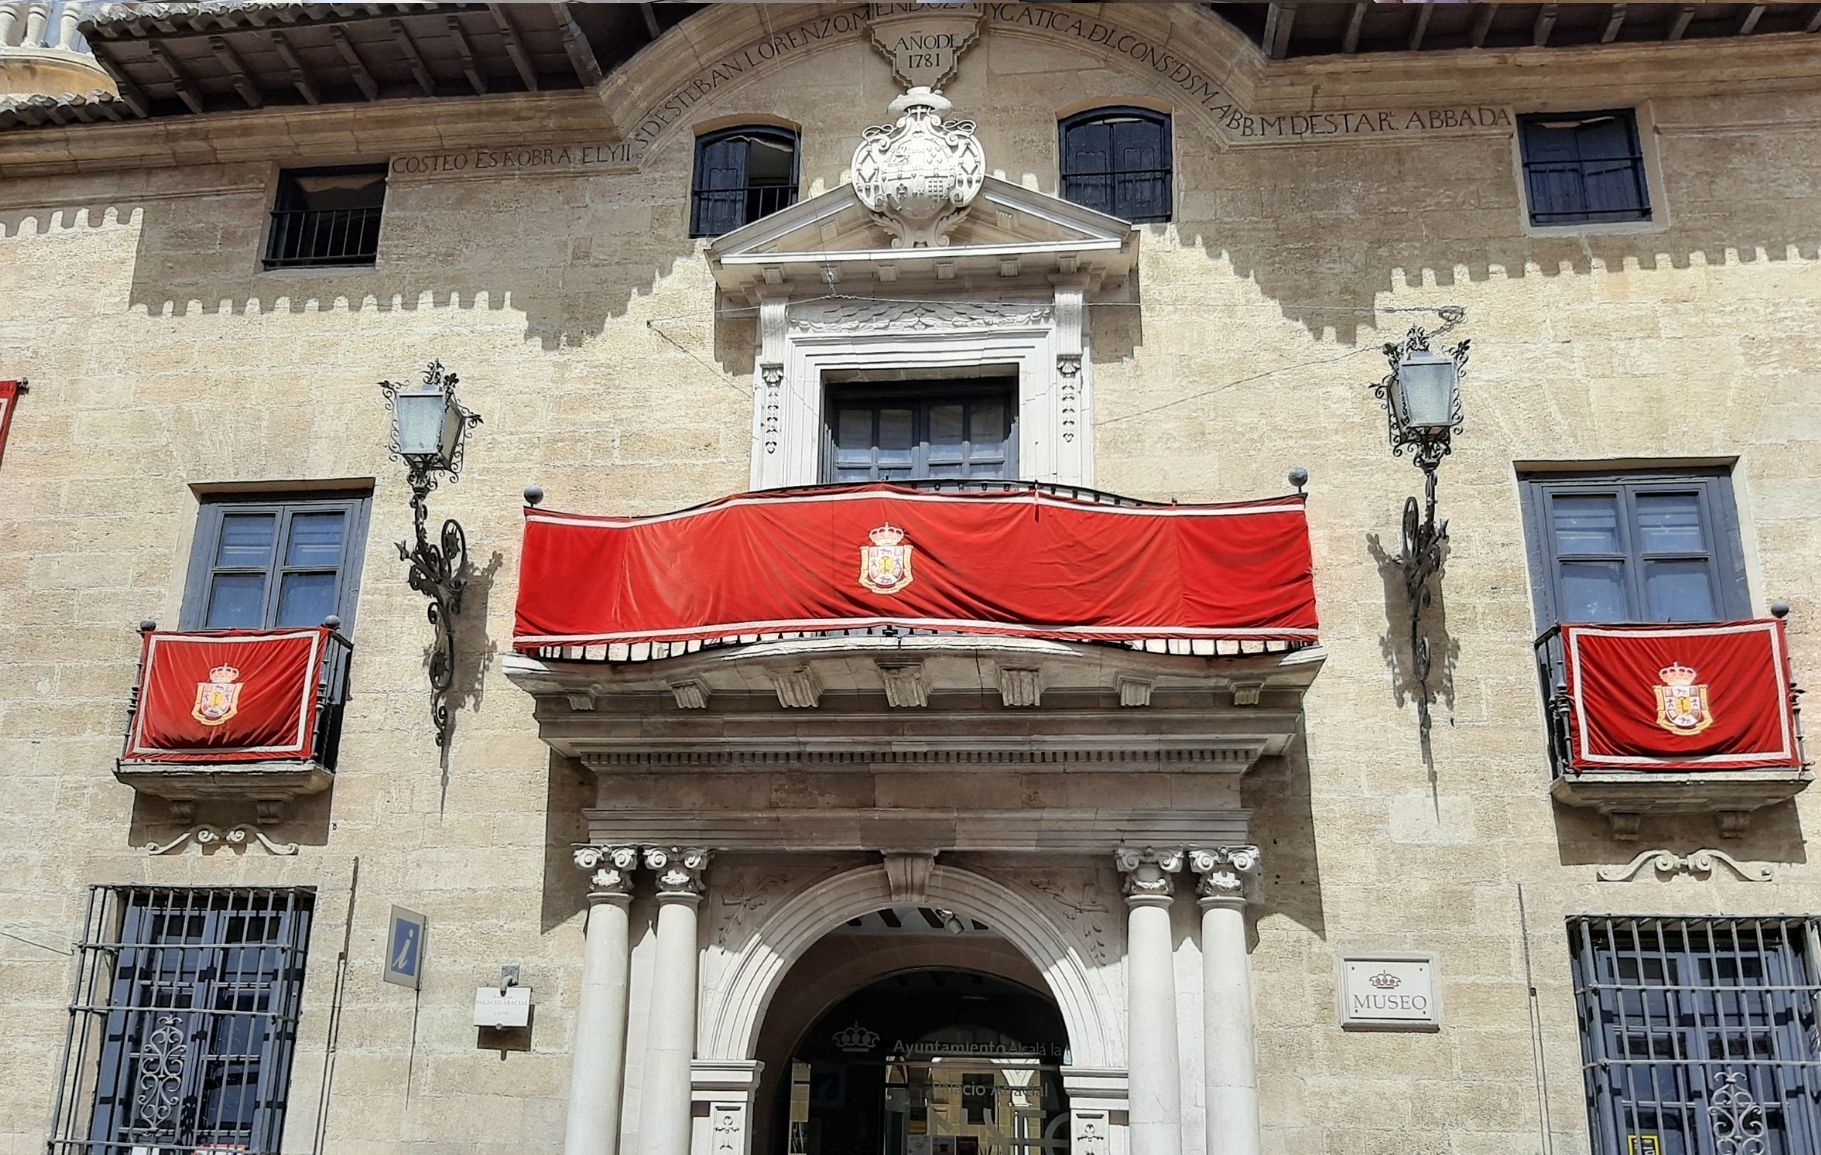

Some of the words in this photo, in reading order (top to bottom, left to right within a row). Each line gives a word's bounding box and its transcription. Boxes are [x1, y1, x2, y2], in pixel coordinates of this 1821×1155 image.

[908, 53, 940, 68] 1781
[392, 153, 468, 174] COSTEO
[1353, 993, 1427, 1010] MUSEO
[893, 1038, 1006, 1057] Ayuntamiento
